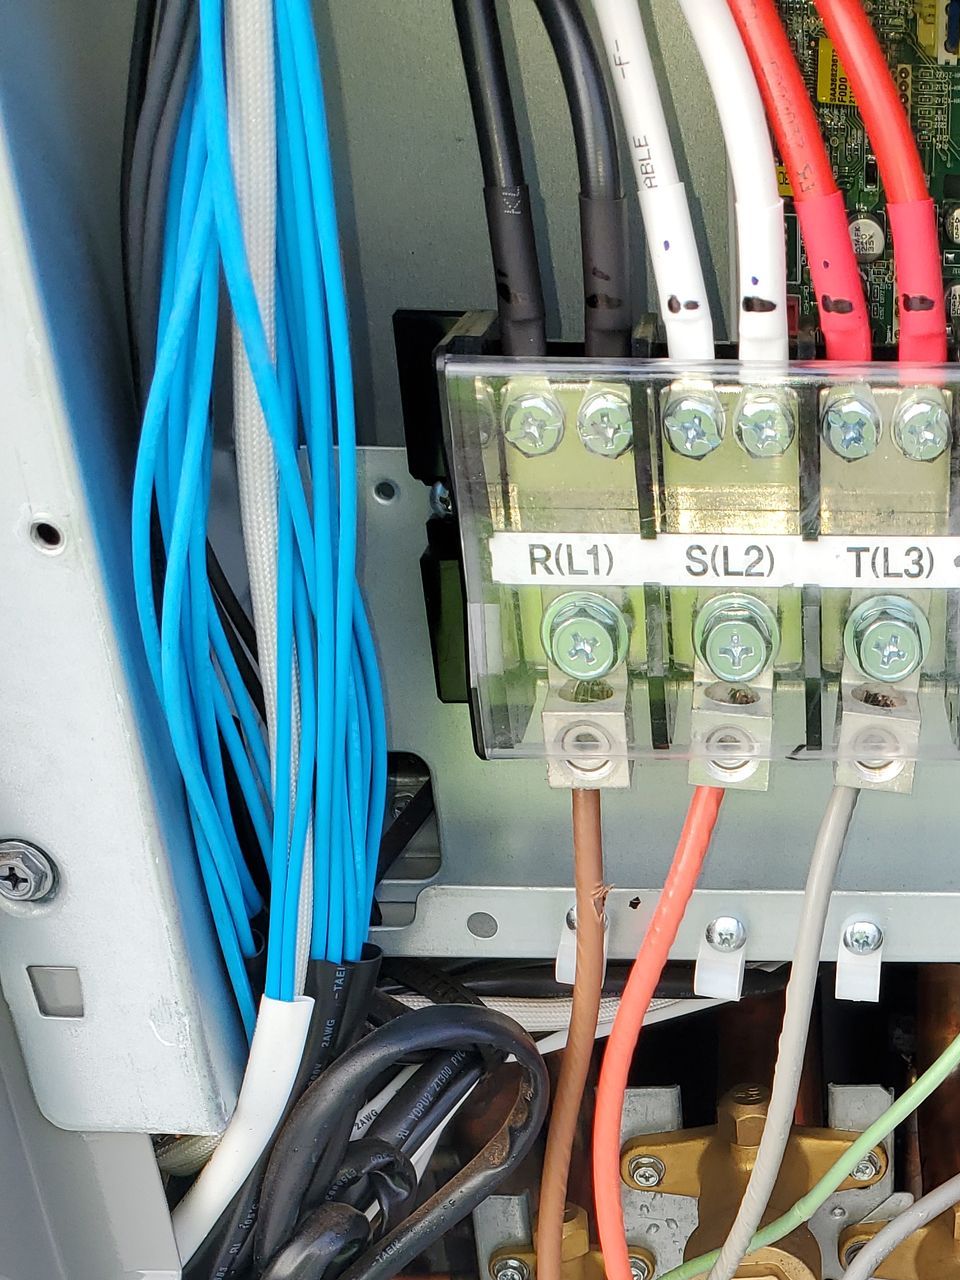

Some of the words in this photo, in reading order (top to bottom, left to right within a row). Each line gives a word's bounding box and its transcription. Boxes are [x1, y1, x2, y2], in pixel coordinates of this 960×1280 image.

[527, 543, 614, 577] R(L1)
[685, 544, 775, 578] S(L2)
[846, 546, 935, 580] T(L3)
[315, 1015, 341, 1050] 2AWG
[354, 1107, 379, 1132] 2AWG
[406, 1090, 436, 1123] YDPU2
